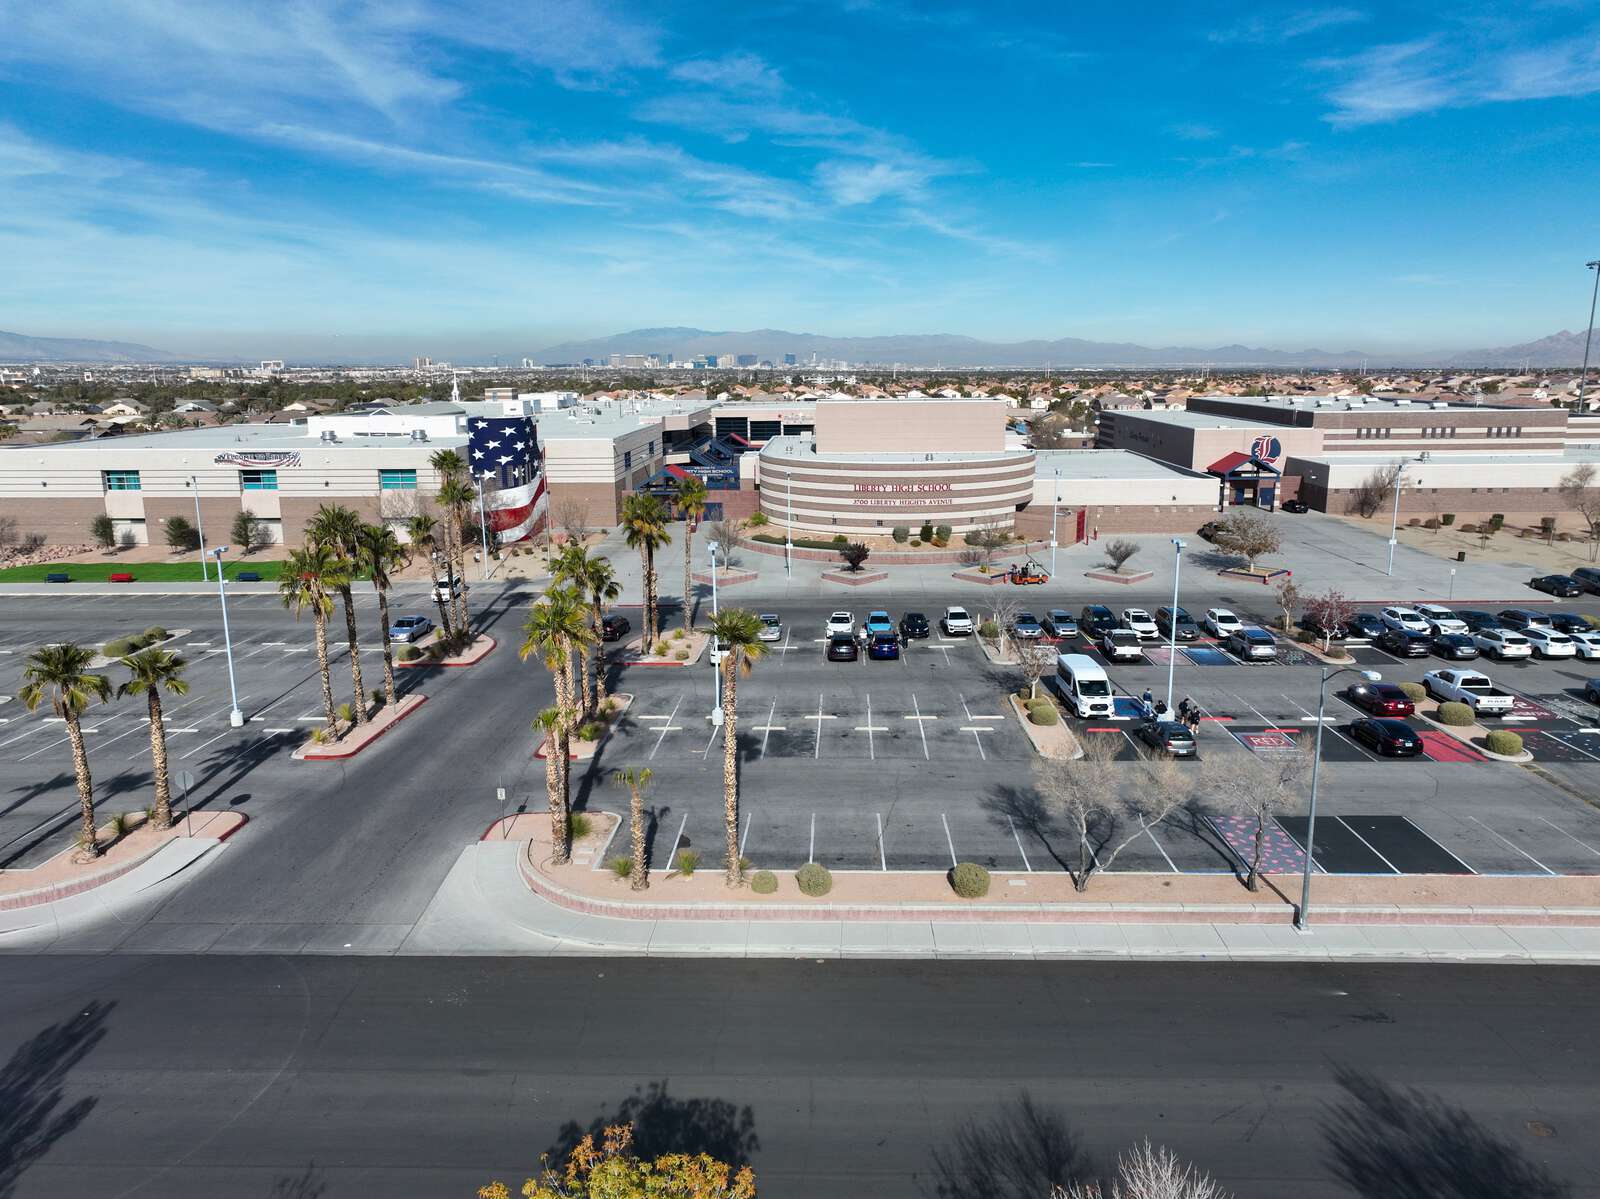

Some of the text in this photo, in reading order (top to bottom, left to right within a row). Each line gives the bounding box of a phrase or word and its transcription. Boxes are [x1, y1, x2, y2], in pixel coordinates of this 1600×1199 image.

[854, 483, 952, 492] LIBERTY HIGH SCHOOL
[1250, 737, 1285, 745] RED
